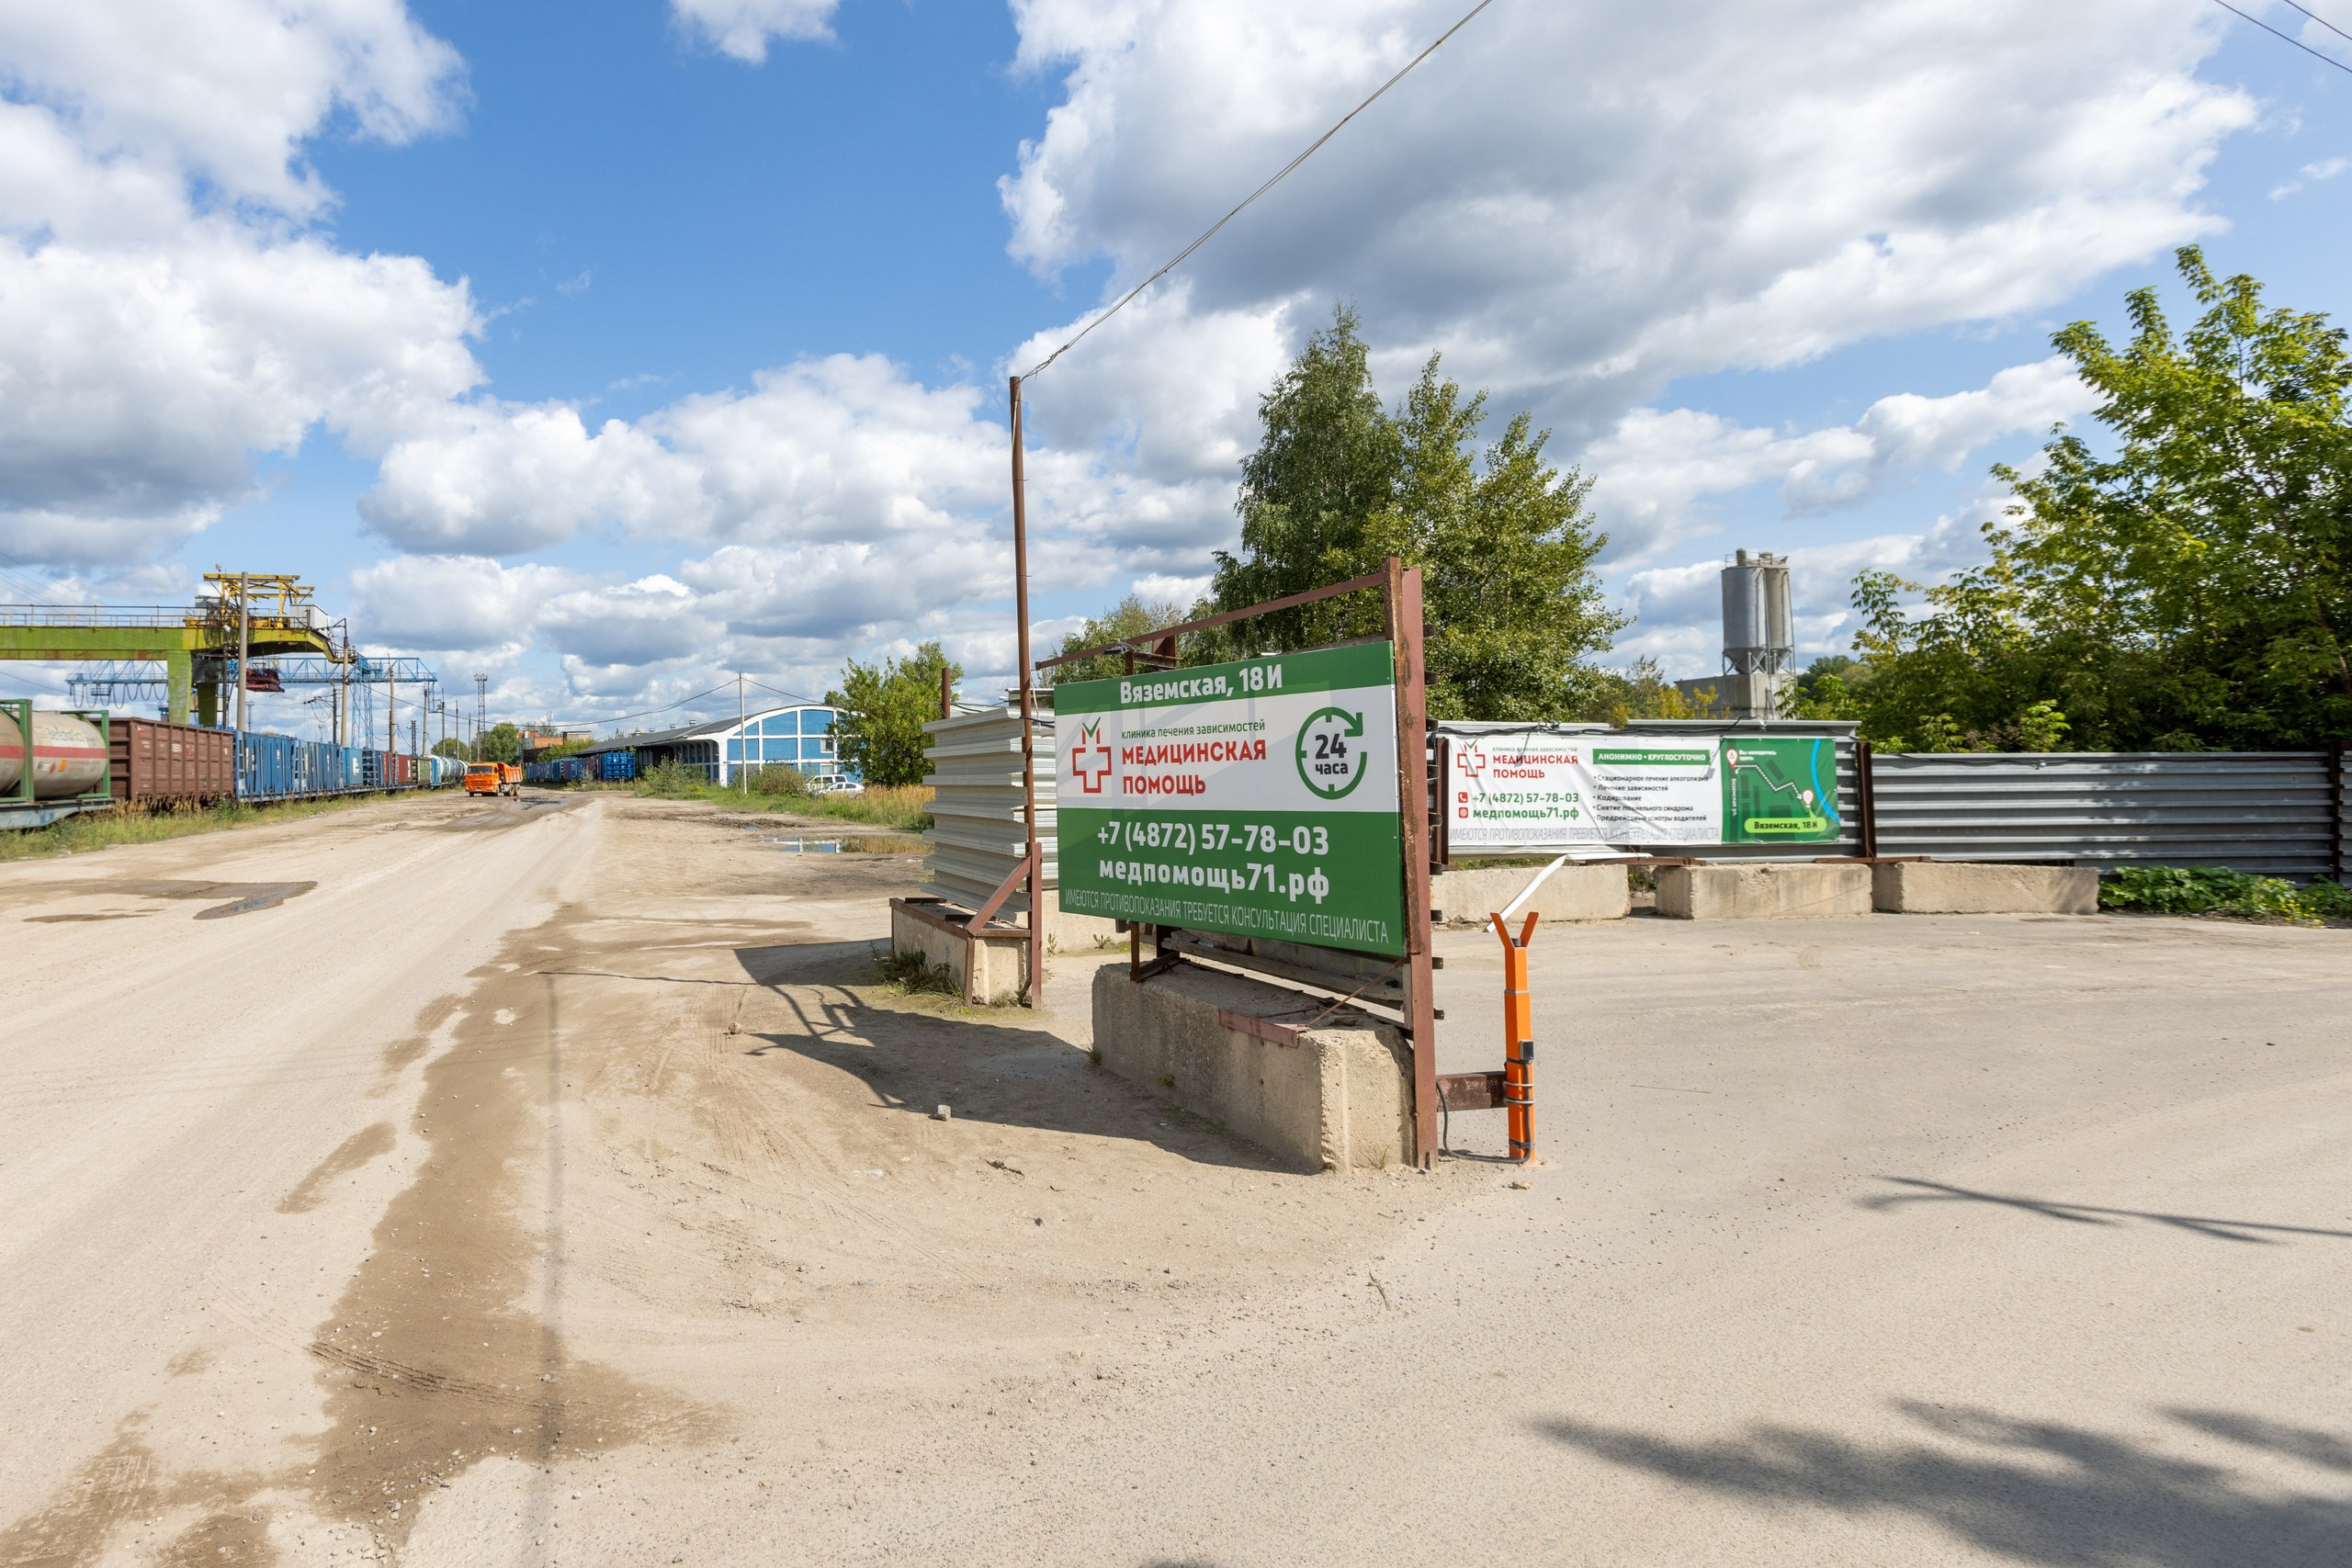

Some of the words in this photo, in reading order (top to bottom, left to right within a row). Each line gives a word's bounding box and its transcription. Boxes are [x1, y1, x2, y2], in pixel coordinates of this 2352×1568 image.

[1120, 676, 1234, 704] Вяземская,
[1121, 728, 1156, 739] клиника
[1158, 725, 1194, 737] лечения
[1196, 719, 1265, 735] зависимостей
[1122, 739, 1266, 766] МЕДИЦИНСКАЯ
[1315, 733, 1347, 759] 24
[1493, 754, 1578, 765] МЕДИЦИНСКАЯ
[1647, 753, 1706, 761] КРУГЛОСУТОЧНО
[1315, 762, 1349, 774] часа
[1493, 769, 1545, 779] ПОМОЩЬ
[1123, 774, 1206, 796] ПОМОЩЬ
[1597, 774, 1645, 783] Стационарное
[1473, 793, 1486, 803] +7
[1488, 793, 1524, 805] (4872)
[1526, 793, 1579, 803] 57-78-03
[1473, 807, 1579, 820] медпомощь71.рф
[1754, 820, 1801, 830] Вяземская,
[1098, 821, 1121, 845] +7
[1125, 822, 1196, 855] (4872)
[1202, 824, 1329, 855] 57-78-03
[1450, 828, 1487, 840] ИМЕЮТСЯ
[1489, 828, 1566, 840] ПРОТИВОПОКАЗАНИЯ
[1099, 860, 1329, 904] медпомощь71.рф
[1065, 888, 1099, 908] ИМЕЮТСЯ
[1101, 892, 1182, 919] ПРОТИВОПОКАЗАНИЯ
[1182, 901, 1229, 924] ТРЕБУЕТСЯ
[1231, 906, 1306, 936] КОНСУЛЬТАЦИЯ
[1309, 914, 1389, 944] СПЕЦИАЛИСТА
